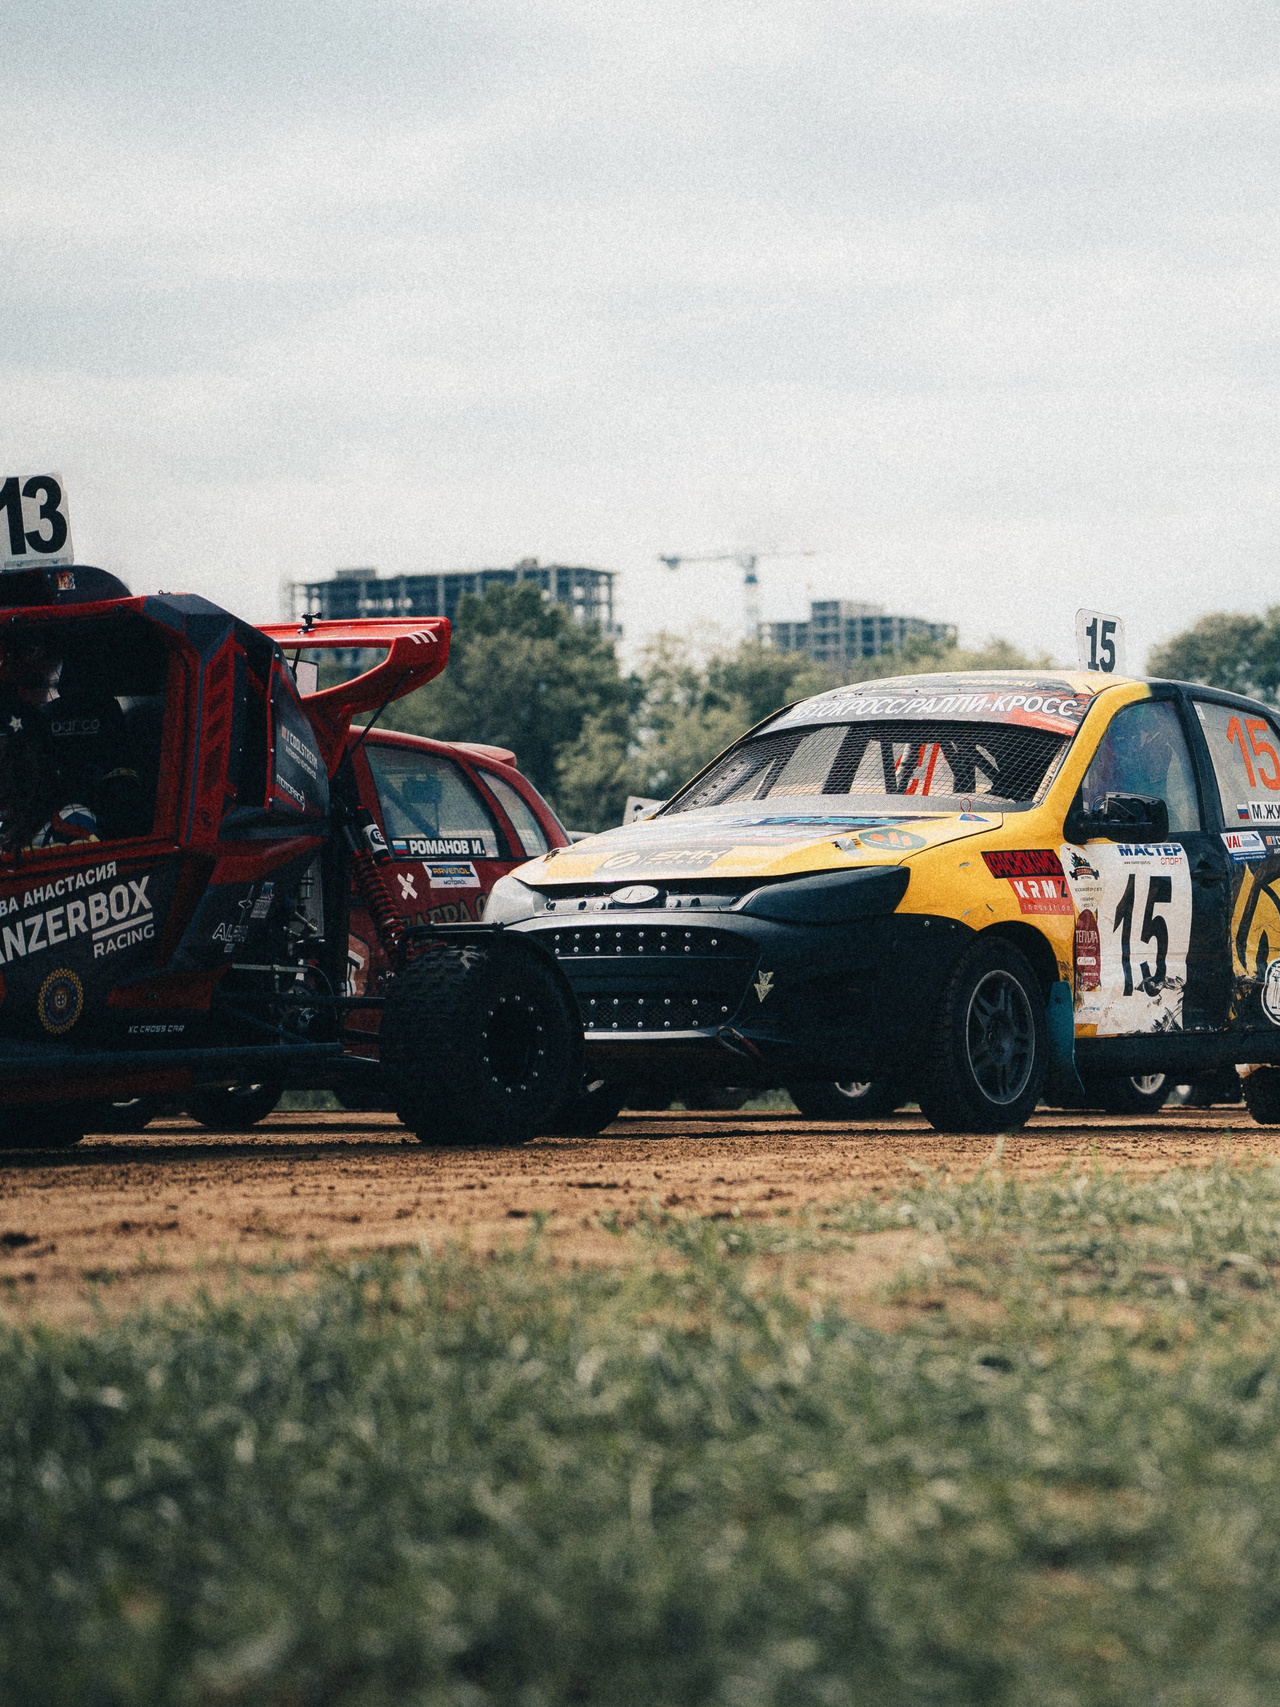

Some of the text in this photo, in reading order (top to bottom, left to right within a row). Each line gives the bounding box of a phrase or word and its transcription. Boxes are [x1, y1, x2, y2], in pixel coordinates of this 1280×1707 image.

[0, 475, 67, 555] 13
[1086, 617, 1116, 673] 15
[786, 695, 1077, 716] АВТОКРОСС/РАЛЛИ-КРОСС
[409, 840, 485, 854] РОМАНОВ И.
[1117, 844, 1182, 856] МАСТЕР
[1160, 857, 1183, 865] СПОРТ
[23, 860, 117, 908] АНАСТАСИЯ
[93, 923, 155, 959] RACING
[1112, 873, 1172, 997] 15
[140, 1025, 166, 1033] CROSS
[168, 1024, 185, 1032] CAR
